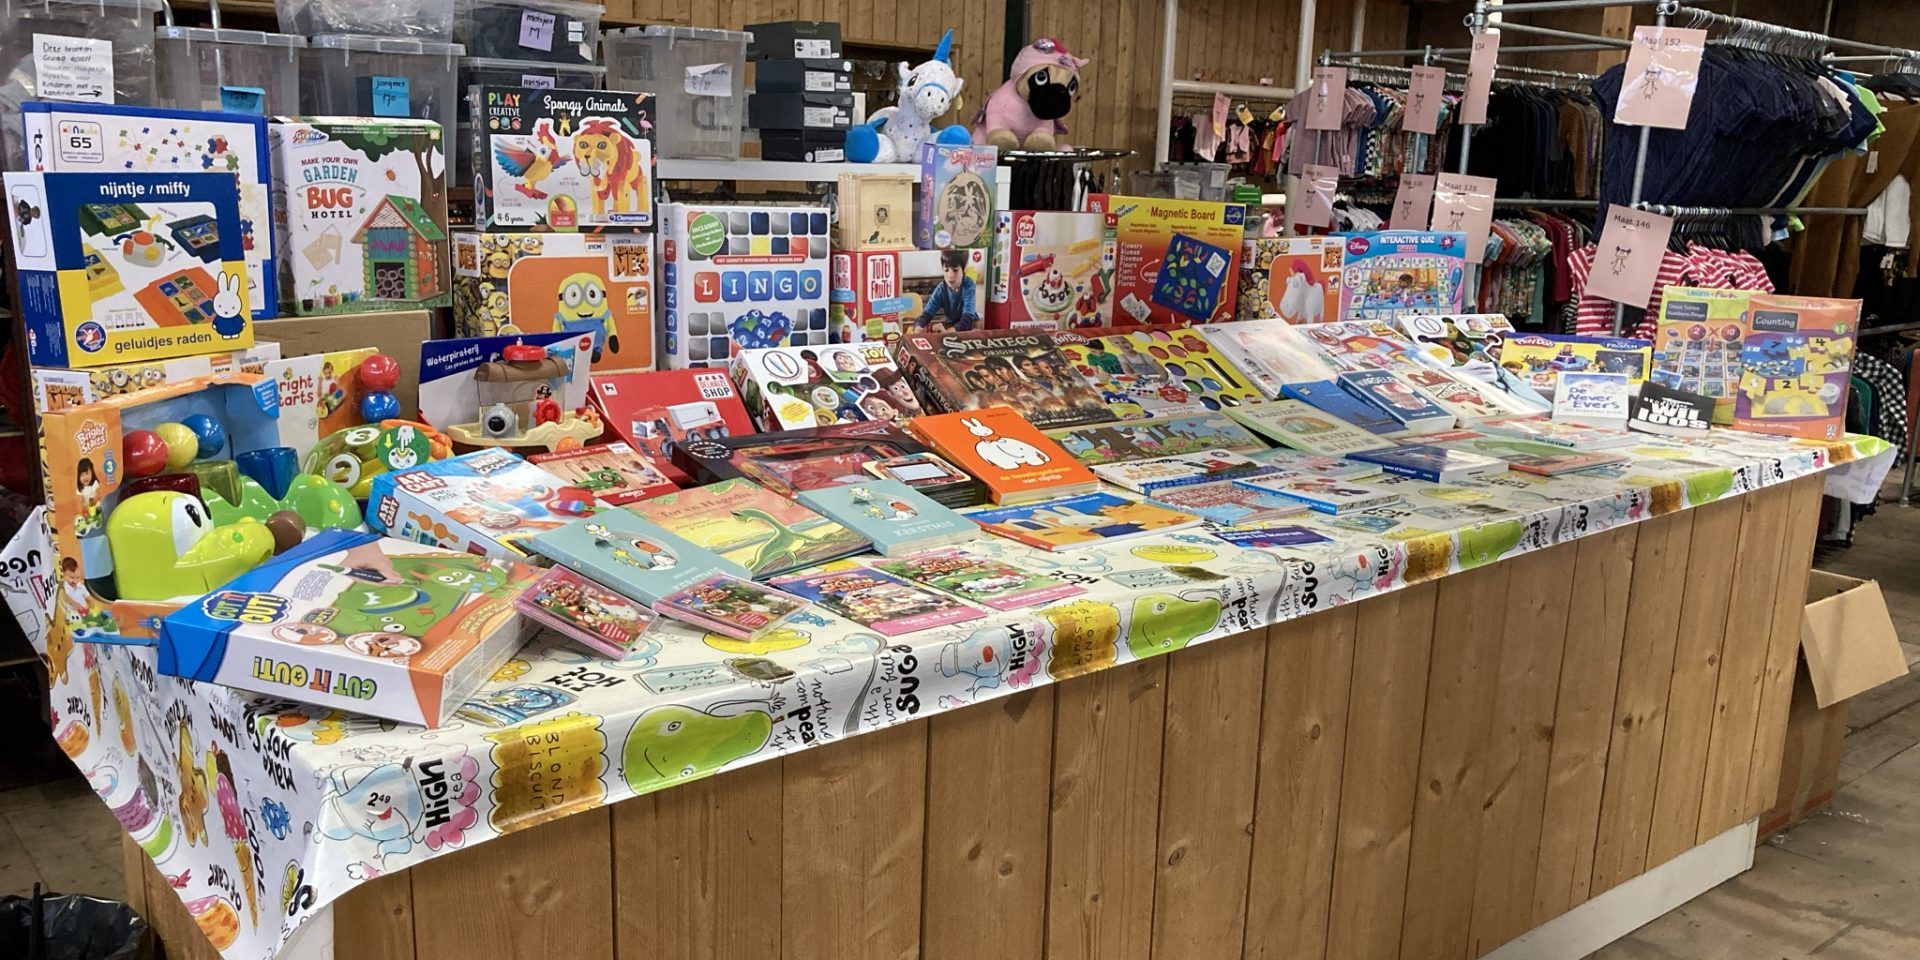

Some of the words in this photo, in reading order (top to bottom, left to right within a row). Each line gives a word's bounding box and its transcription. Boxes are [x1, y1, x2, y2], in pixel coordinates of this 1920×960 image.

[1664, 38, 1681, 46] 152
[488, 92, 521, 107] PLAY
[543, 95, 584, 117] Spongy
[585, 96, 628, 113] Animals
[489, 107, 520, 117] CREATIVE
[70, 136, 92, 149] 65
[301, 158, 319, 166] MAKE
[322, 156, 341, 164] YOUR
[343, 156, 359, 165] OWN
[303, 165, 358, 183] GARDEN
[100, 181, 145, 198] nijntje
[156, 181, 190, 197] miffy
[306, 186, 353, 210] BUG
[311, 210, 353, 219] HOTEL
[1150, 206, 1189, 221] Magnetic
[1190, 208, 1216, 220] Board
[1635, 219, 1652, 230] 146
[702, 275, 817, 297] LINGO
[1755, 316, 1796, 328] Counting
[114, 334, 175, 354] geluidjes
[177, 332, 212, 346] raden
[943, 335, 1040, 358] STRATEGO
[426, 343, 480, 368] Waterpiraterij
[279, 375, 314, 395] right
[702, 386, 731, 398] SHOP
[278, 391, 314, 407] tarts
[334, 460, 351, 484] 2
[400, 472, 432, 486] ART
[404, 478, 447, 493] CRAFT
[251, 655, 308, 687] OUT!
[333, 673, 378, 701] CUT
[545, 732, 566, 806] BLOND
[449, 771, 464, 802] tea
